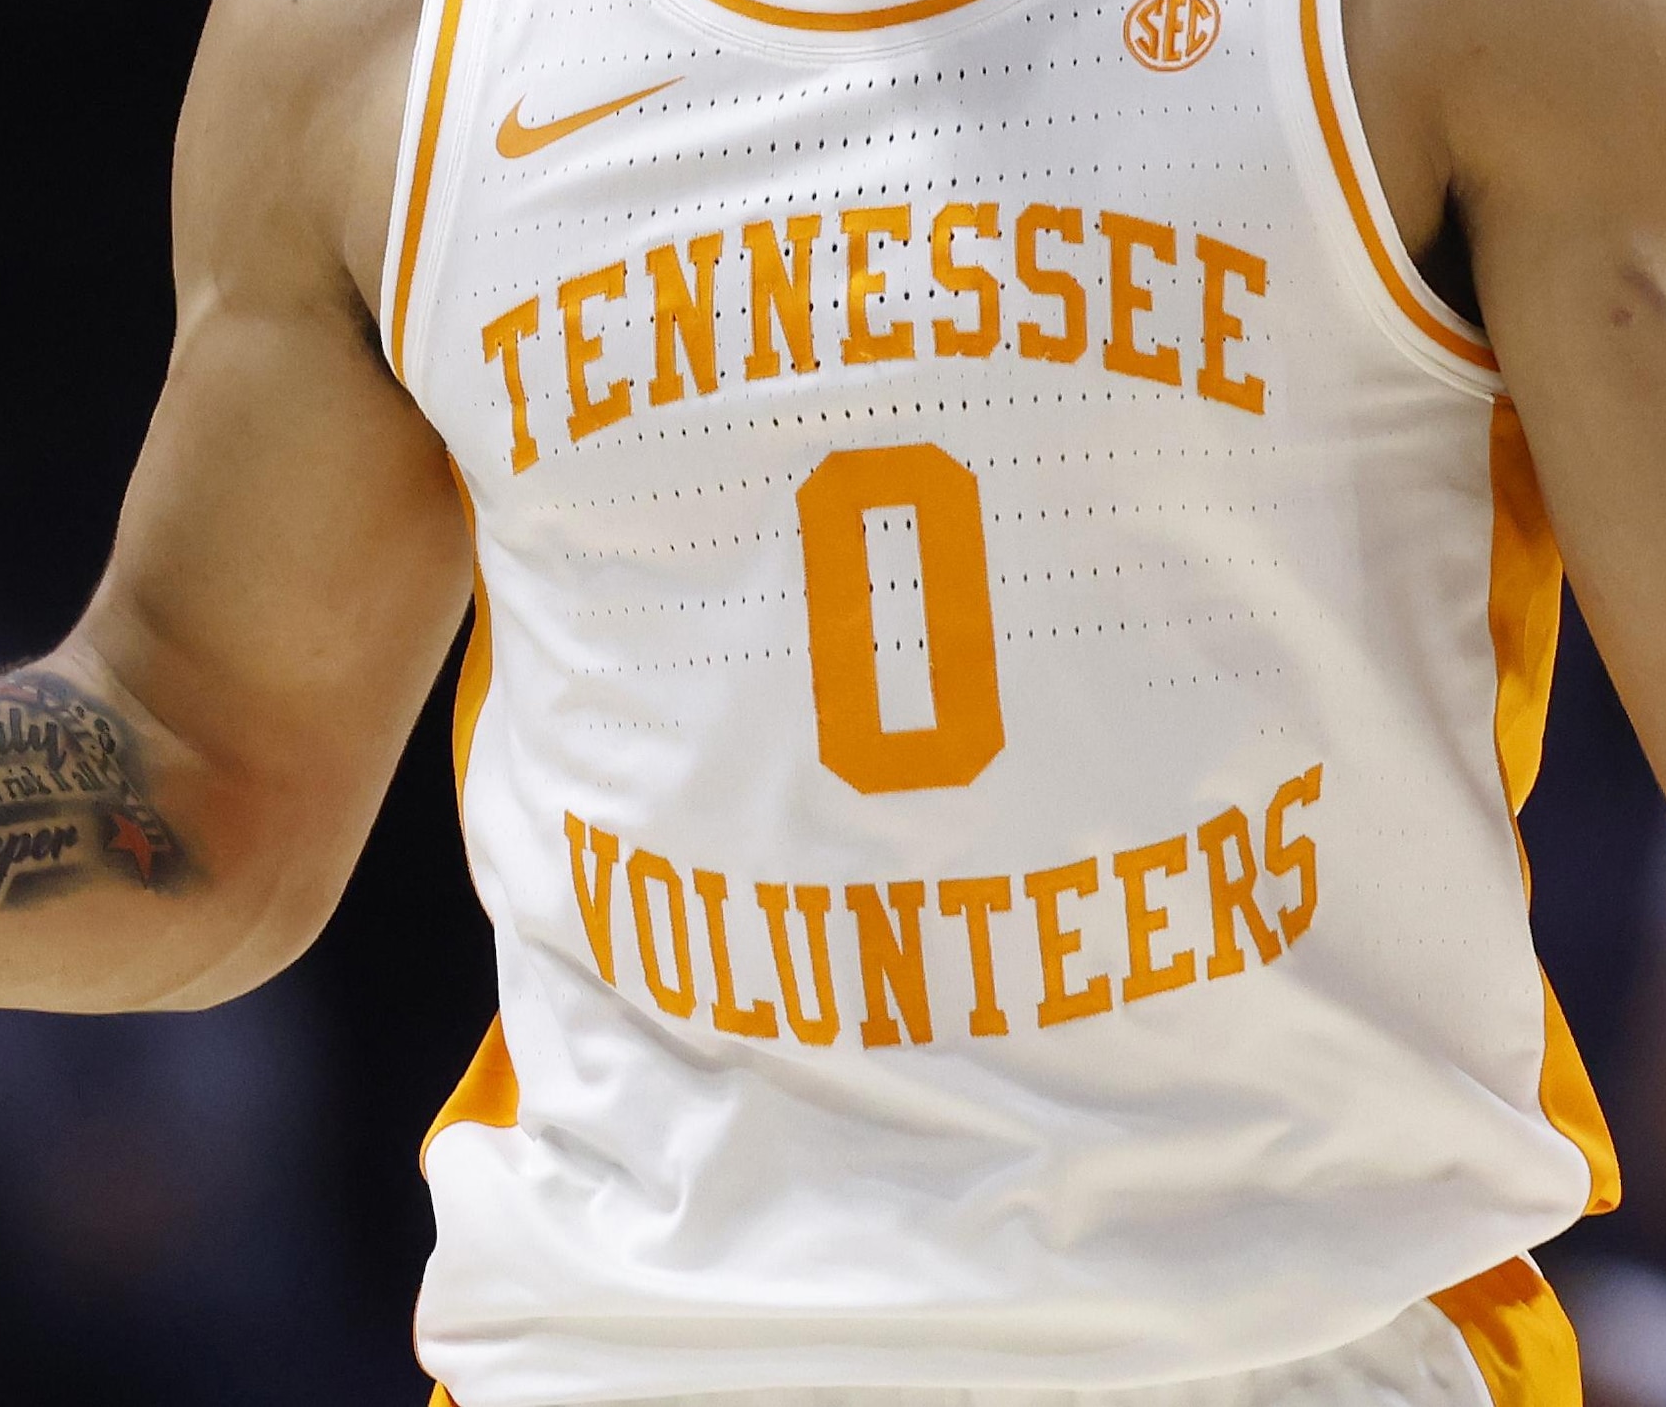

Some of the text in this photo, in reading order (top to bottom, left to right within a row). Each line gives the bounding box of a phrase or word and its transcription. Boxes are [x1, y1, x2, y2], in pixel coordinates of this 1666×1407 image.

[481, 201, 1269, 475] TENNESSEE
[794, 441, 1007, 796] 0
[563, 763, 1324, 1050] VOLUNTEERS
